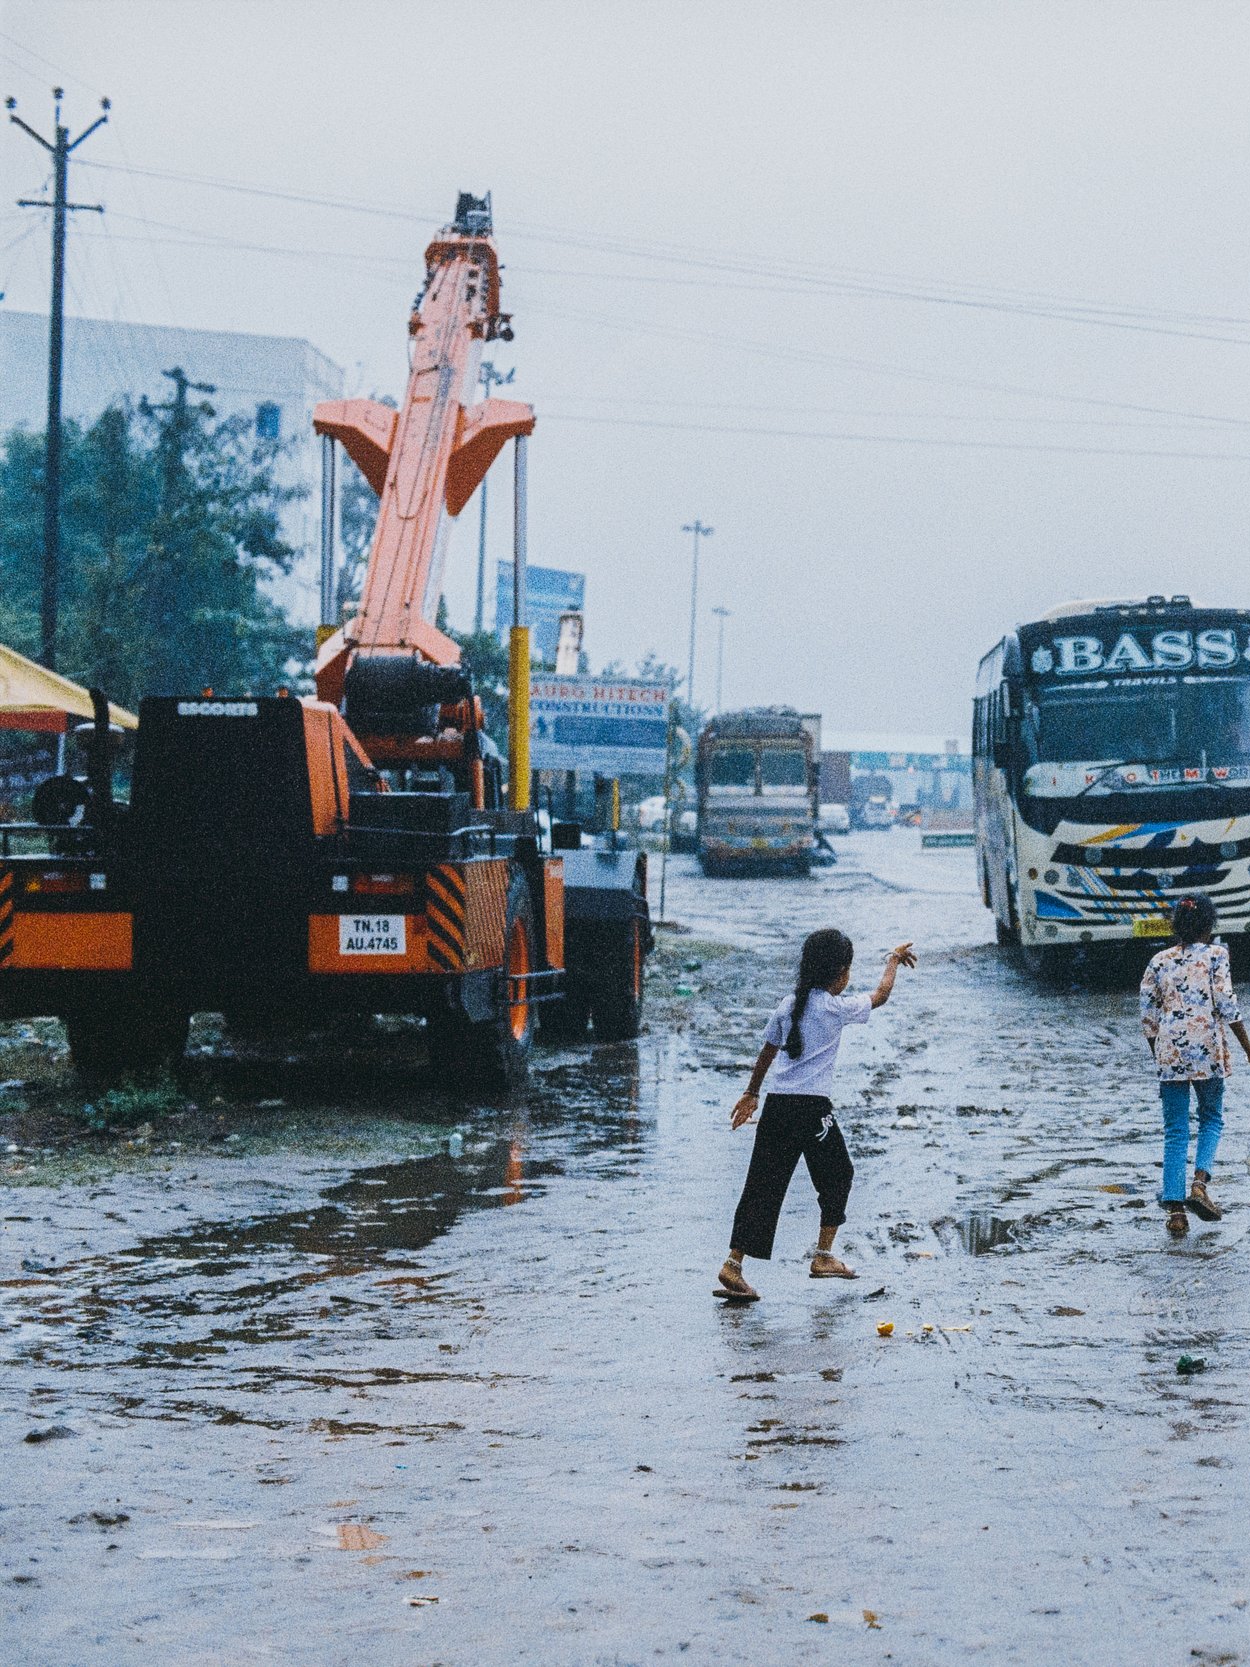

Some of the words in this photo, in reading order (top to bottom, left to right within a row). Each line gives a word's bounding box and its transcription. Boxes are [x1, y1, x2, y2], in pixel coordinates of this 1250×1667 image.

[1053, 628, 1239, 676] BASS
[594, 687, 666, 702] HITECH
[346, 936, 398, 950] AU.4745
